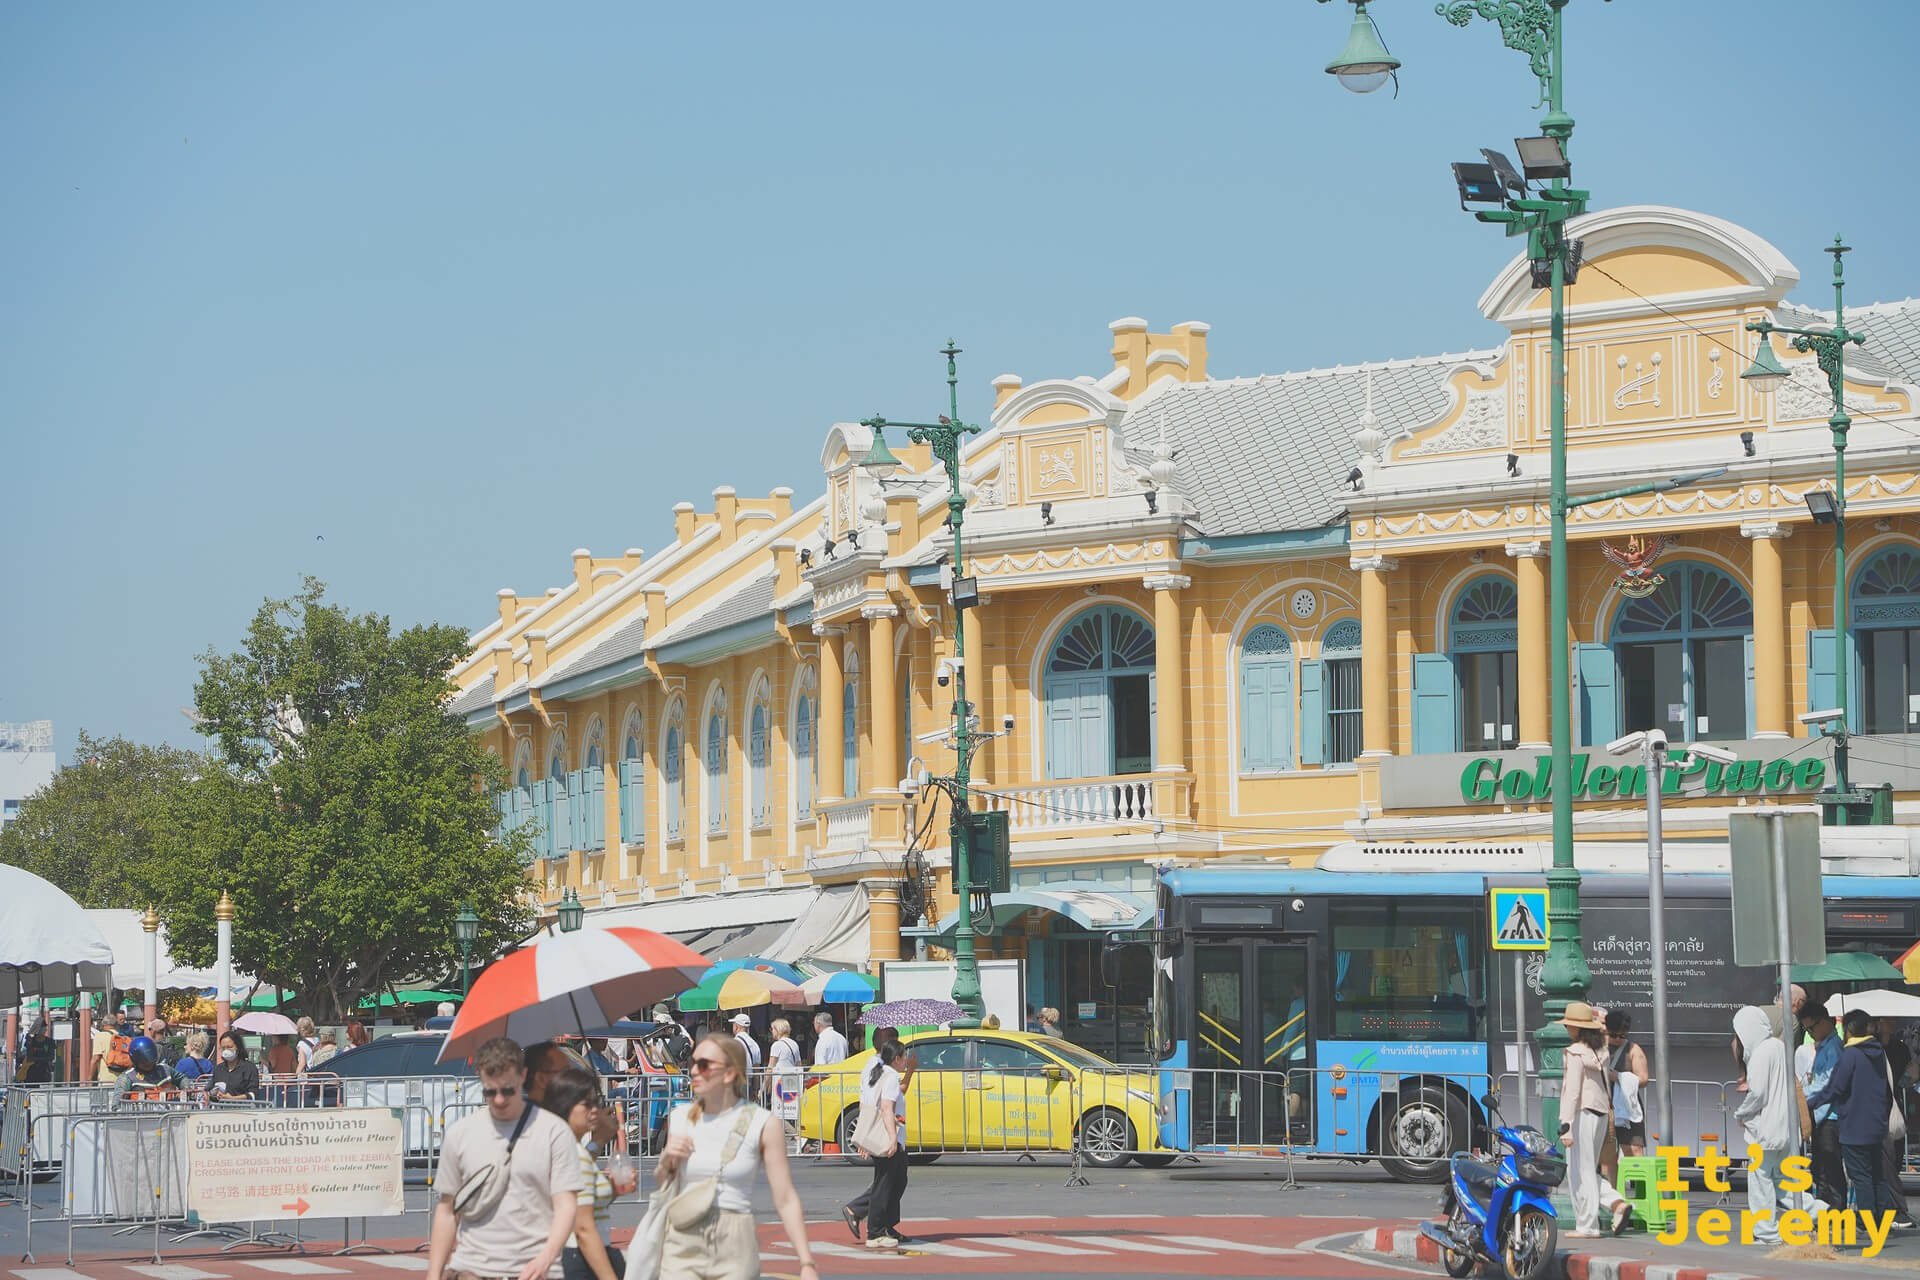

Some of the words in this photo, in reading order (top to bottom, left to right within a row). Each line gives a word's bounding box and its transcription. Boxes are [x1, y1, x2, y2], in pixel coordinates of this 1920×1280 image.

[1661, 749, 1825, 794] Place
[1593, 935, 1704, 956] เสด็จสู่สวคาลัย
[196, 1116, 367, 1135] ข้ามถนนโปรดใช้ทางม้าลาย
[195, 1132, 319, 1150] บริเวณด้านหน้าร้าน
[325, 1134, 362, 1143] Golden
[366, 1133, 395, 1142] Place
[194, 1159, 233, 1168] PLEASE
[235, 1157, 270, 1167] CROSS
[272, 1156, 291, 1165] THE
[294, 1155, 322, 1164] ROAD
[340, 1153, 358, 1162] THE
[360, 1152, 392, 1162] ZEBRA
[194, 1168, 246, 1177] CROSSING
[248, 1167, 258, 1175] IN
[260, 1166, 294, 1175] FRONT
[296, 1164, 309, 1173] OF
[311, 1164, 330, 1173] THE
[332, 1164, 362, 1172] Golden
[311, 1184, 349, 1193] Golden
[351, 1183, 381, 1192] Place
